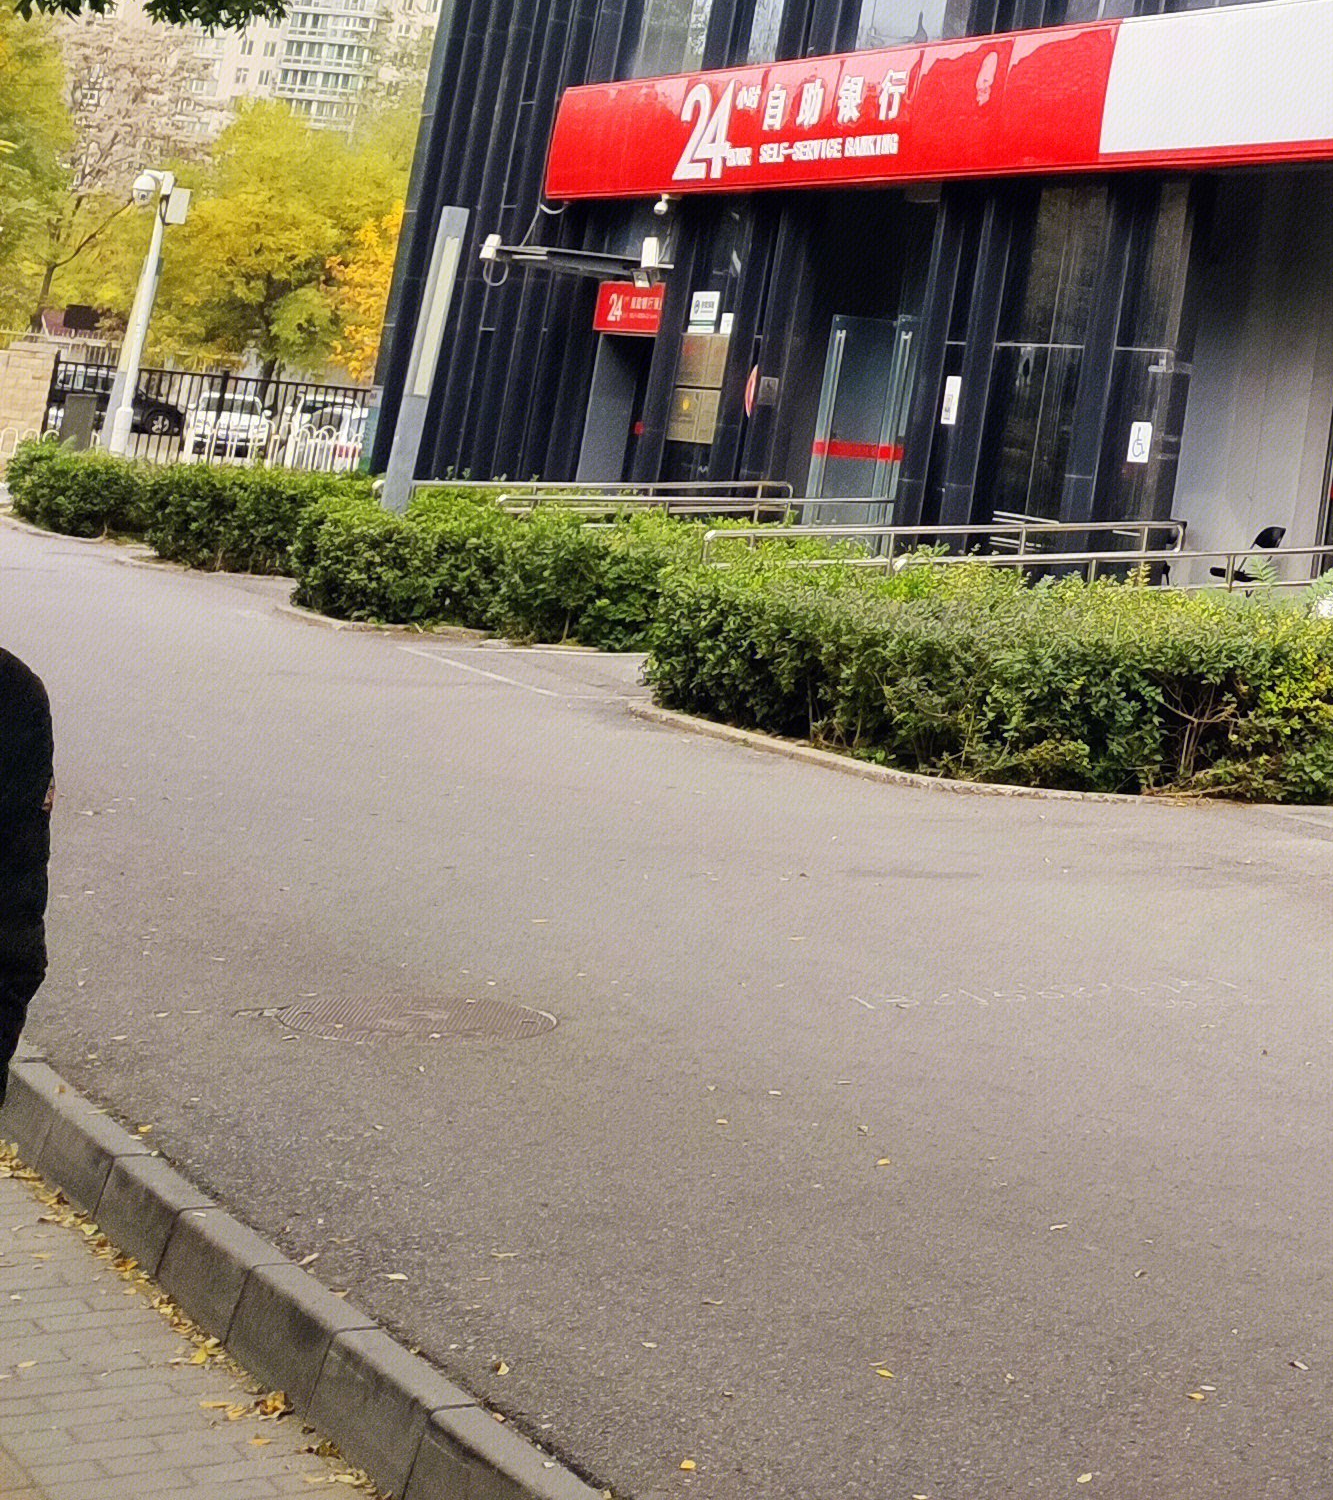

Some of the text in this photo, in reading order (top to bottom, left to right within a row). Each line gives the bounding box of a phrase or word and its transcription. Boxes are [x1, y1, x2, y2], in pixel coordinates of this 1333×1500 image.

[671, 79, 736, 181] 24
[762, 69, 908, 130] 自助银行
[759, 136, 843, 164] SELF-SERVICE
[844, 132, 899, 157] BANKING
